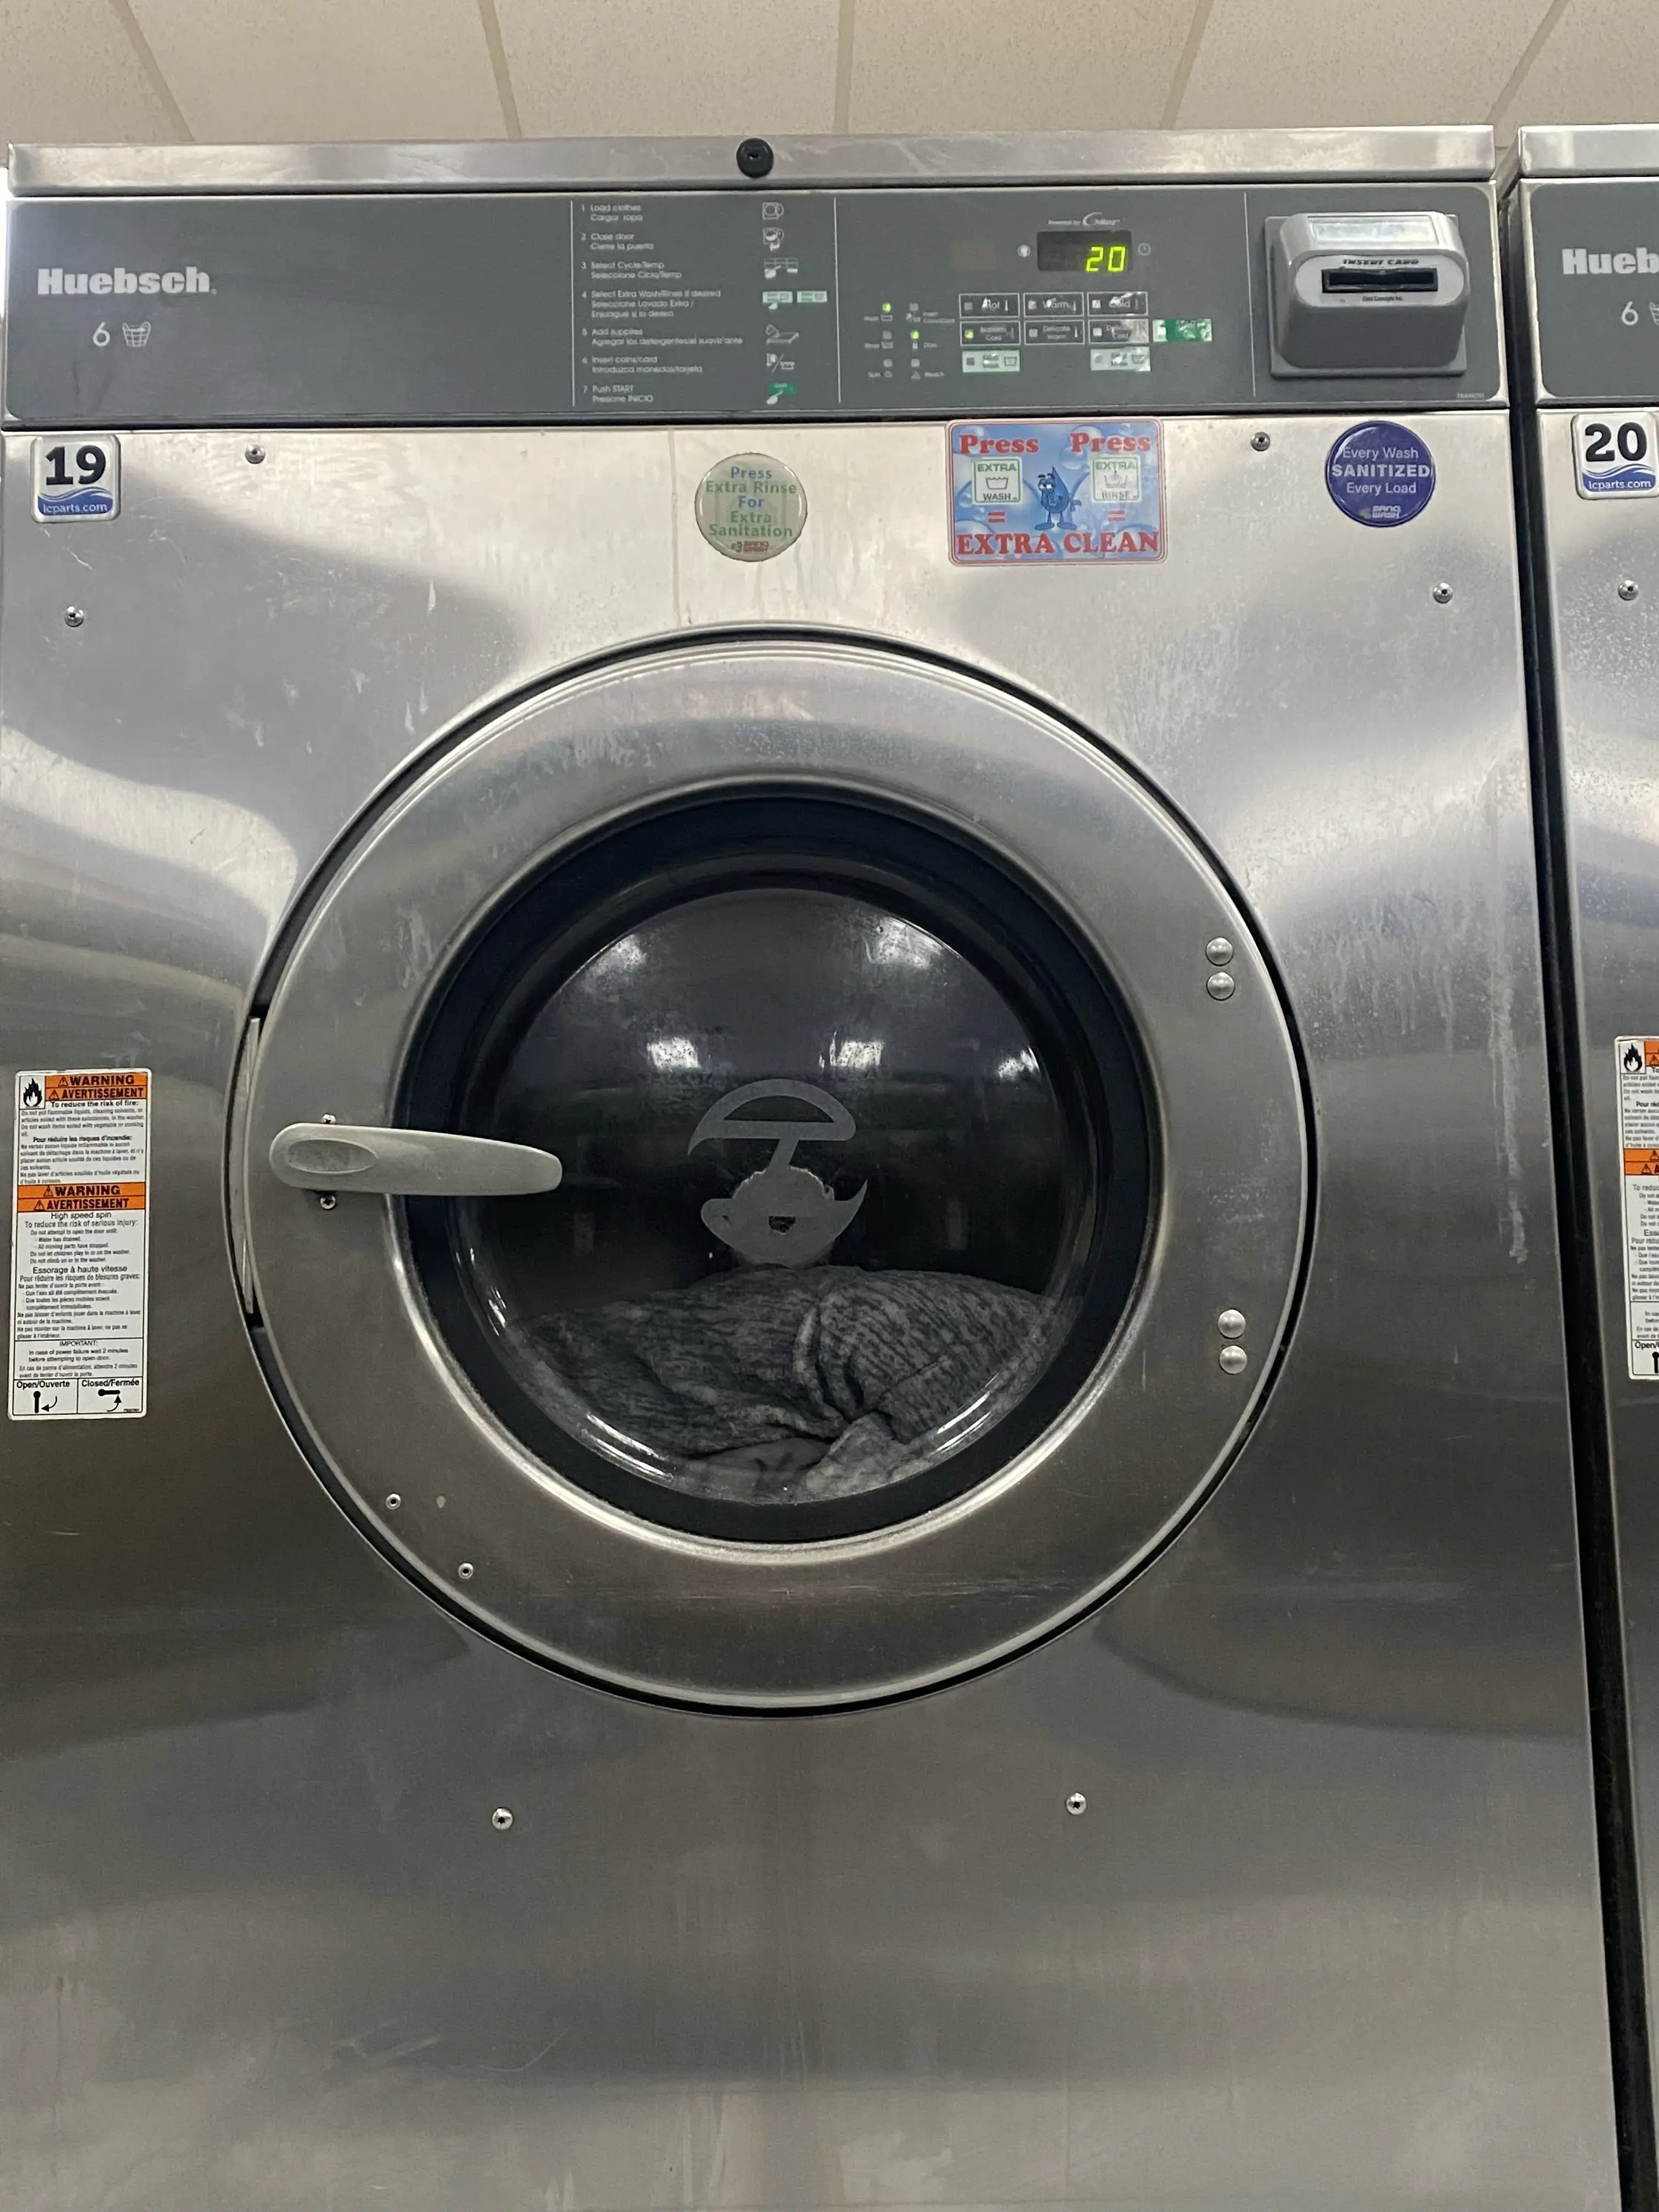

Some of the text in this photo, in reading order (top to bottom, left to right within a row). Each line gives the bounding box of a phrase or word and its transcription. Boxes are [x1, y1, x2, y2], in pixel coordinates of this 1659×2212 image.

[1086, 246, 1125, 272] 20
[37, 267, 214, 295] Huebsch
[1621, 301, 1639, 325] 6
[93, 321, 110, 346] 6
[959, 434, 1039, 454] Press
[1070, 432, 1150, 453] Press
[1584, 421, 1647, 462] 20
[1343, 447, 1418, 461] Every Wash
[45, 445, 106, 485] 19
[978, 464, 1017, 472] EXTRA
[1096, 461, 1136, 470] EXTRA
[1332, 464, 1430, 477] SANITIZED
[731, 467, 772, 478] Press
[706, 481, 797, 493] Extra Rinse
[1347, 482, 1417, 496] Every Load
[983, 493, 1012, 501] WASH
[1102, 490, 1130, 500] RINSE
[739, 496, 764, 507] For
[731, 511, 771, 523] Extra
[709, 524, 792, 537] Sanitation
[956, 531, 1158, 555] EXTRA CLEAN
[70, 1075, 134, 1085] WARNING
[62, 1088, 143, 1099] AVERTISSEMENT
[55, 1186, 120, 1196] WARNING
[47, 1198, 129, 1209] AVERTISSEMENT
[16, 1380, 70, 1390] Open/Ouverte
[82, 1378, 139, 1387] Closed/Fermée
